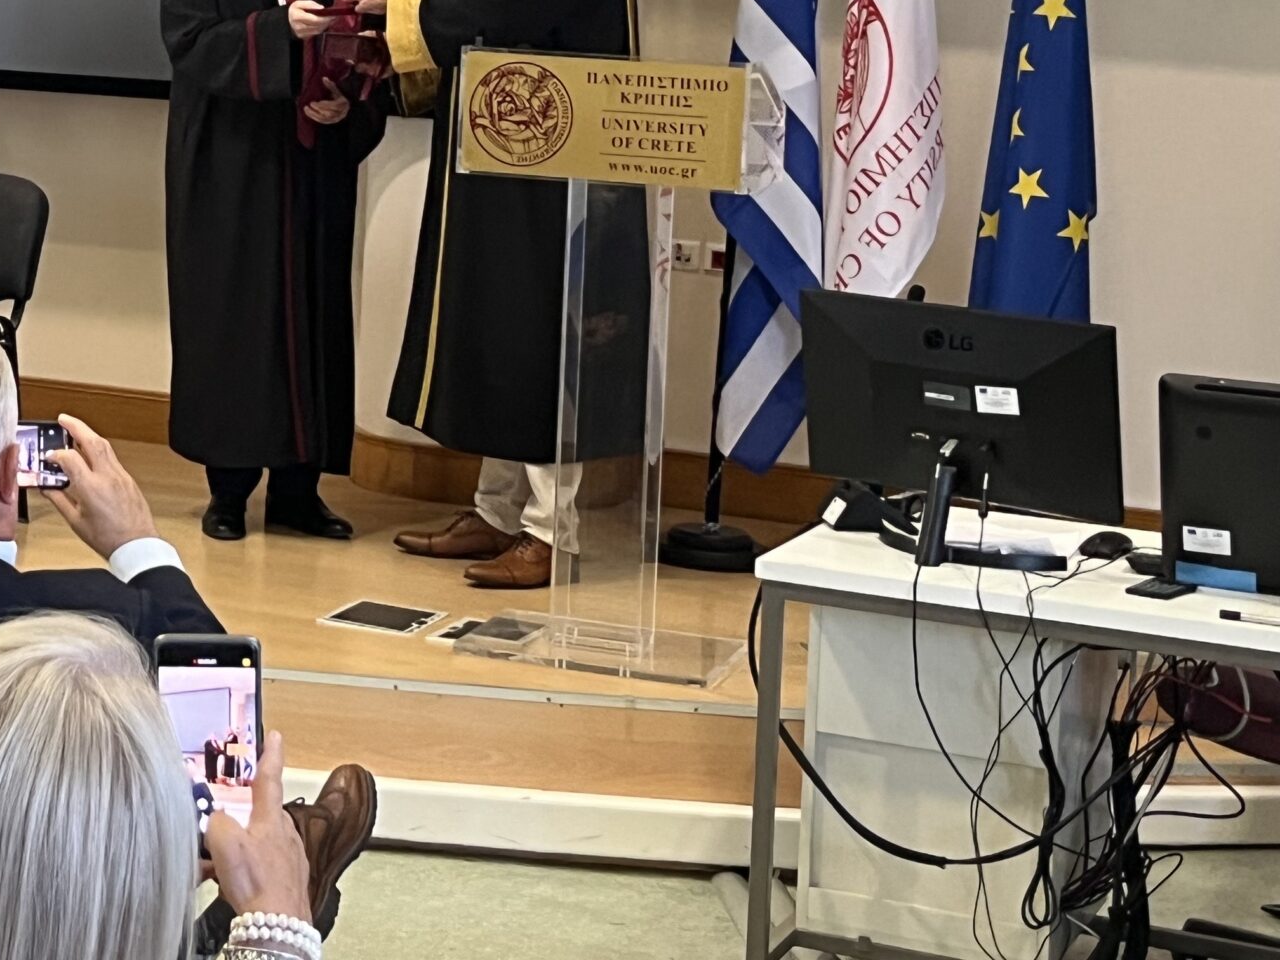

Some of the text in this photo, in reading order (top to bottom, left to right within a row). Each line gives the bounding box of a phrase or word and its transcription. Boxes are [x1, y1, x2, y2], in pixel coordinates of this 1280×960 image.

[587, 71, 729, 92] ΠΑΝΕΠΙΣΤΗΜΙΟ
[620, 91, 693, 108] ΚΡΗΤΗΣ
[601, 117, 709, 137] UNIVERSITY
[611, 136, 697, 153] OF CRETE
[608, 162, 698, 179] www.uoc.gr
[949, 334, 974, 351] LG
